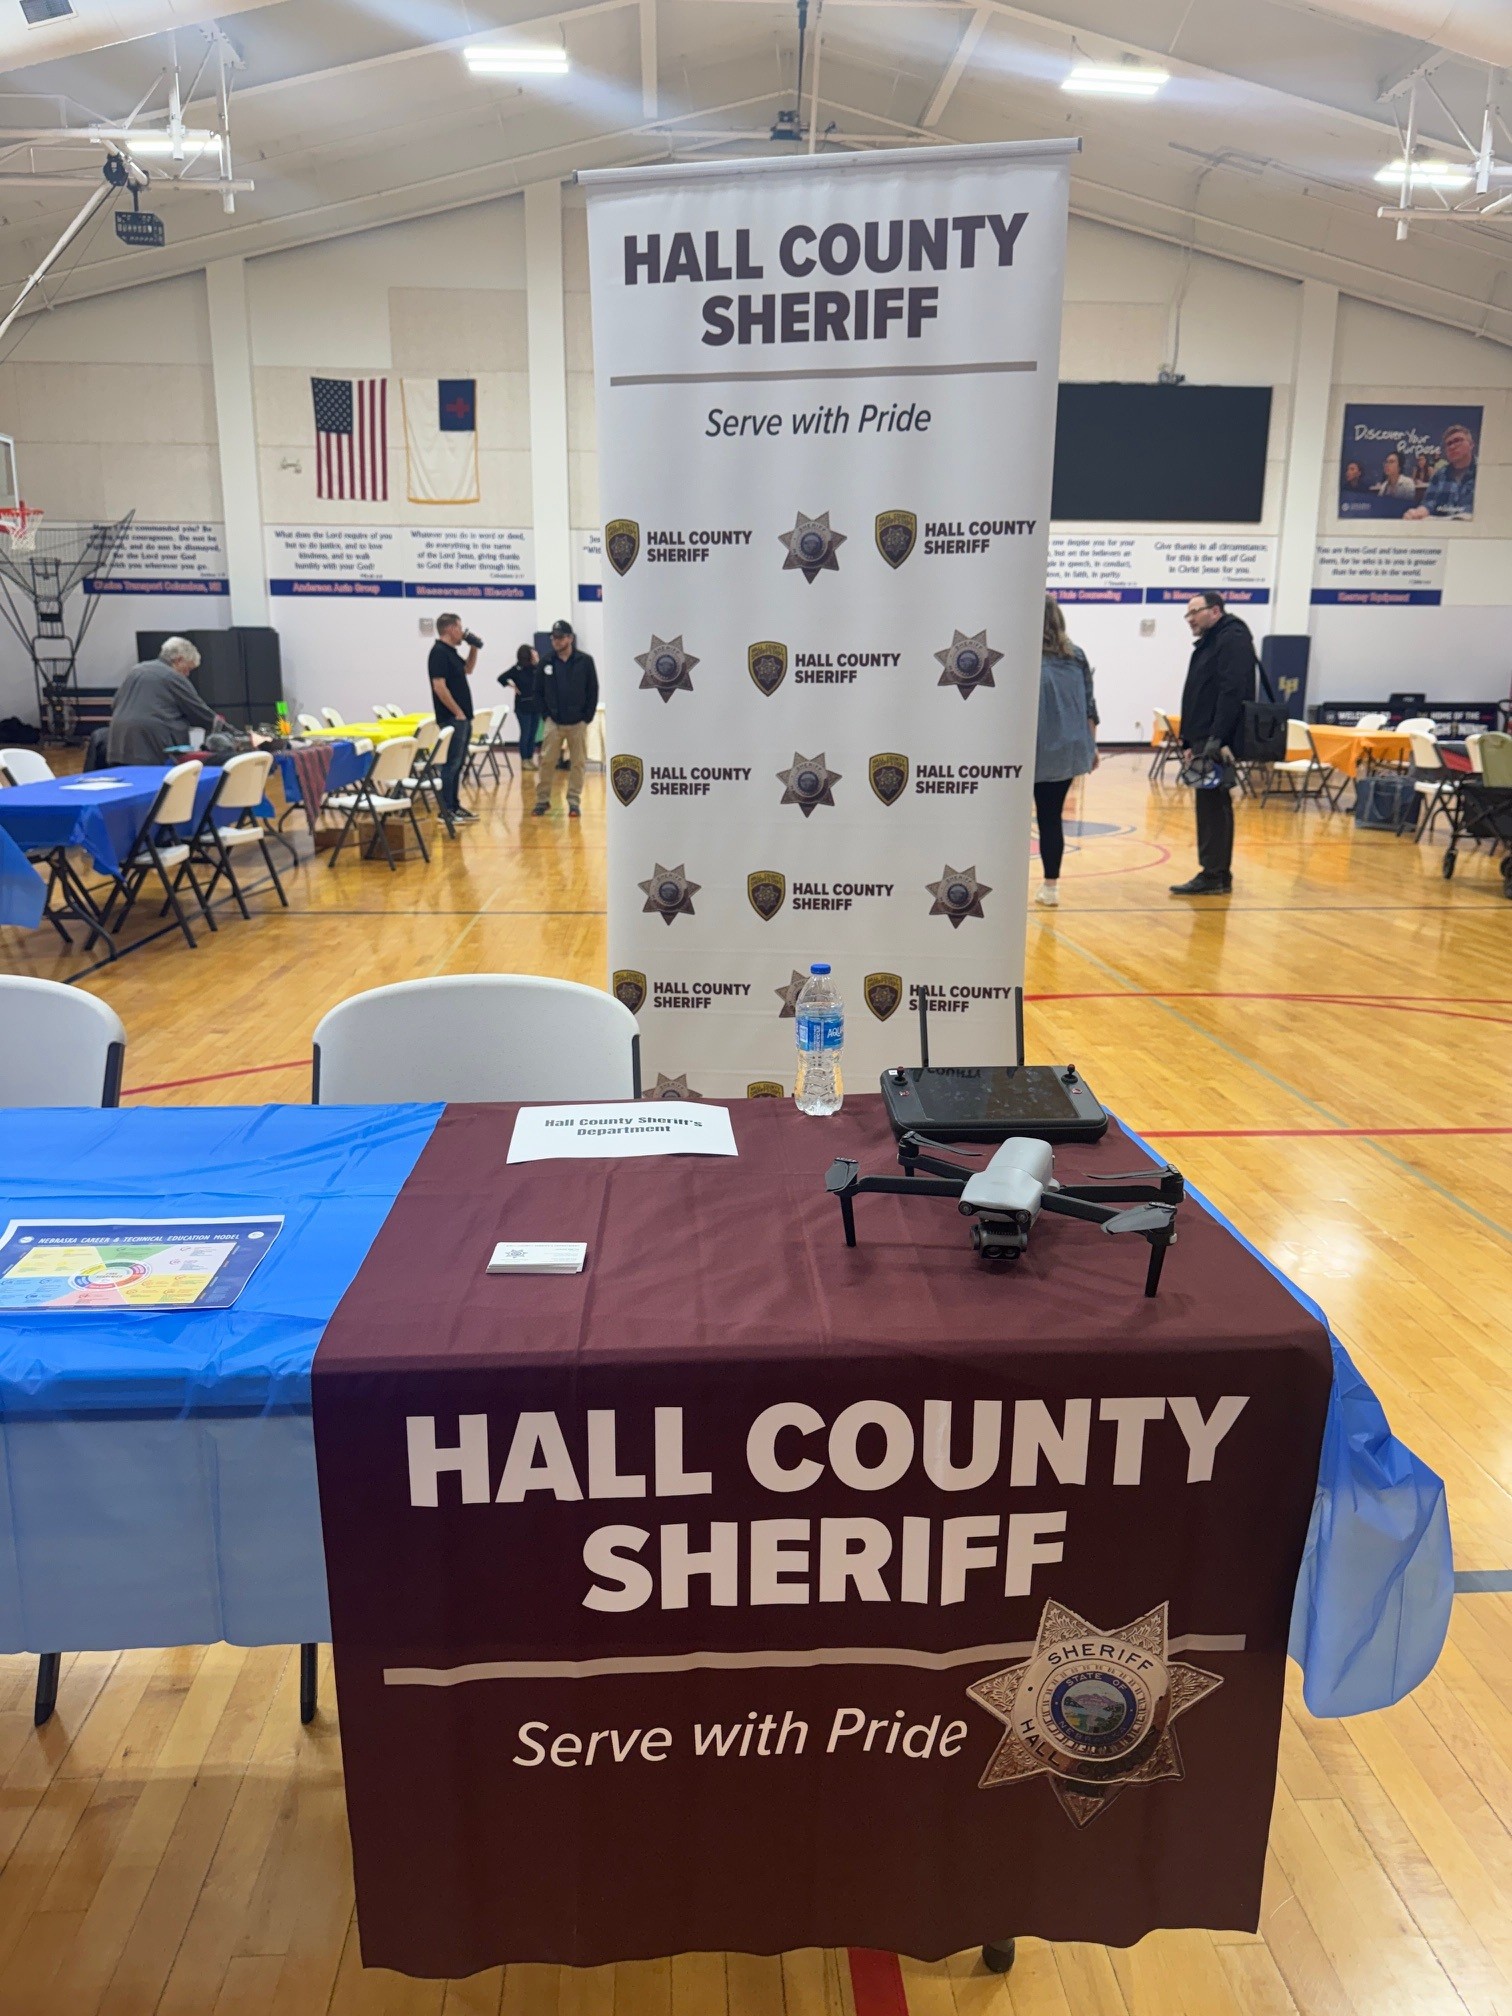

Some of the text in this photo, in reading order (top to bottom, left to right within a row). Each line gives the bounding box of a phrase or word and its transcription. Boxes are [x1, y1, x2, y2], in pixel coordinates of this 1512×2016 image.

[624, 212, 1029, 286] HALL COUNTY
[701, 286, 939, 347] SHERIFF
[705, 402, 931, 438] Serve with Pride
[925, 522, 965, 537] HALL
[968, 520, 1036, 536] COUNTY
[647, 530, 752, 545] HALL COUNTY
[924, 539, 990, 554] SHERIFF
[647, 548, 710, 562] SHERIFF
[795, 653, 833, 667] HALL
[837, 653, 901, 667] COUNTY
[795, 670, 857, 684] SHERIFF
[1430, 711, 1452, 720] HOME
[1453, 711, 1464, 720] OF
[650, 767, 752, 781] HALL COUNTY
[916, 765, 1023, 779] HALL COUNTY
[650, 782, 710, 796] SHERIFF
[915, 781, 979, 795] SHERIFF
[793, 882, 894, 897] HALL COUNTY
[792, 898, 853, 911] SHERIFF
[653, 981, 752, 996] HALL COUNTY
[950, 986, 1012, 1000] COUNTY
[653, 996, 712, 1009] SHERIFF
[909, 999, 970, 1012] SERIFF
[545, 1116, 703, 1127] Hall County Sheriff's
[577, 1125, 671, 1136] Department
[81, 1236, 110, 1244] CAREER
[167, 1234, 210, 1242] EDUCATION
[405, 1396, 1250, 1507] HALL COUNTY
[581, 1510, 1068, 1613] SHERIFF
[1048, 1643, 1154, 1672] SHERIFF
[1065, 1672, 1128, 1691] STATE OF
[513, 1705, 968, 1769] Serve with Pride
[1020, 1718, 1061, 1767] HALL
